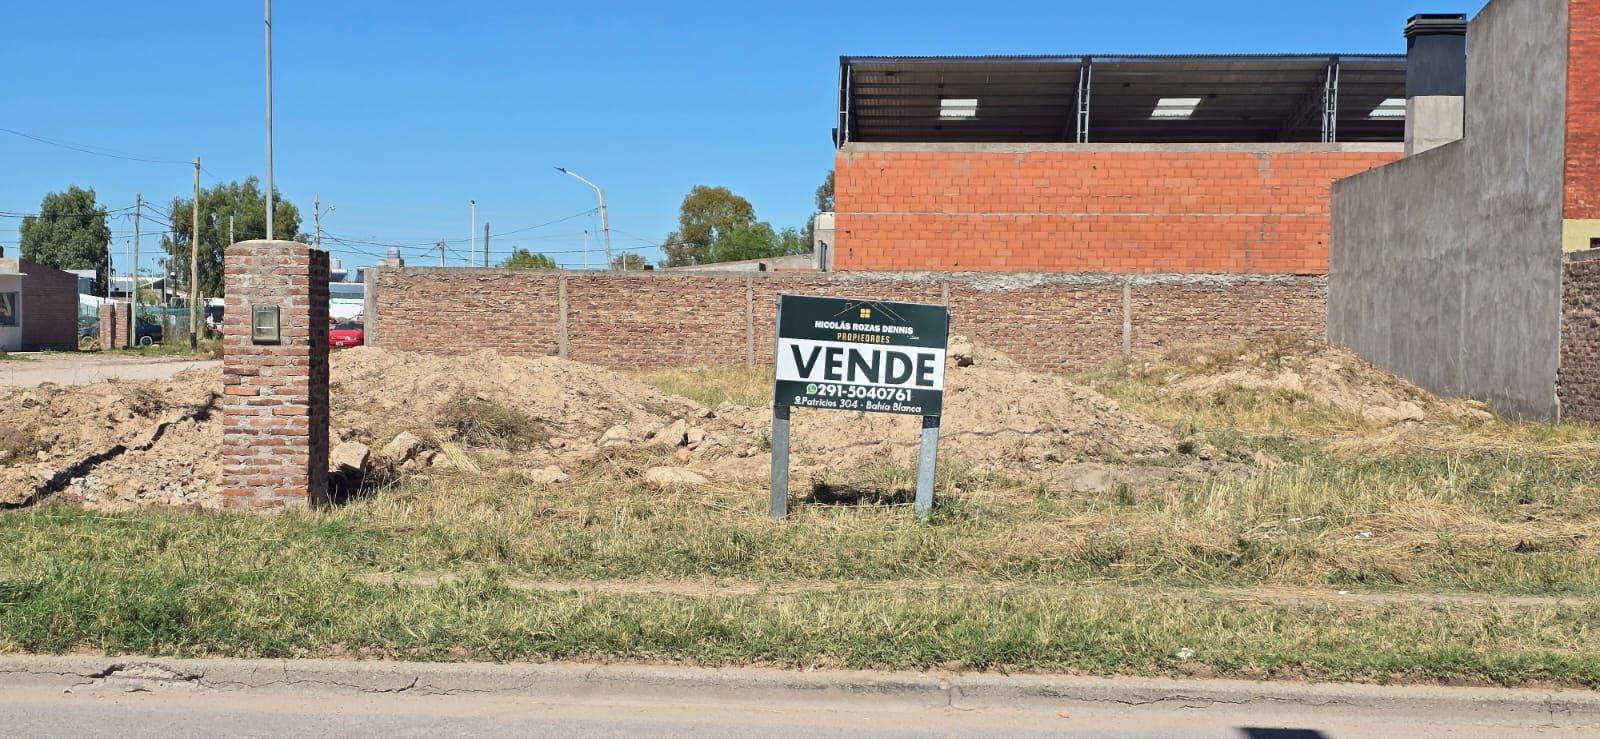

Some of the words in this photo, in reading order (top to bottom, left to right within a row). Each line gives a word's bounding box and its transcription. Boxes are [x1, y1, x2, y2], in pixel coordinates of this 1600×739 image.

[815, 320, 850, 331] NICOLÁS
[853, 323, 880, 333] ROZAS
[882, 325, 913, 335] DENNIS
[837, 332, 890, 344] PROPIEDADES
[791, 344, 935, 387] VENDE
[818, 384, 911, 402] 291-5040761
[802, 397, 837, 408] Patricios
[839, 399, 858, 409] 304
[866, 401, 891, 411] Bahía
[893, 403, 922, 413] Blanca
